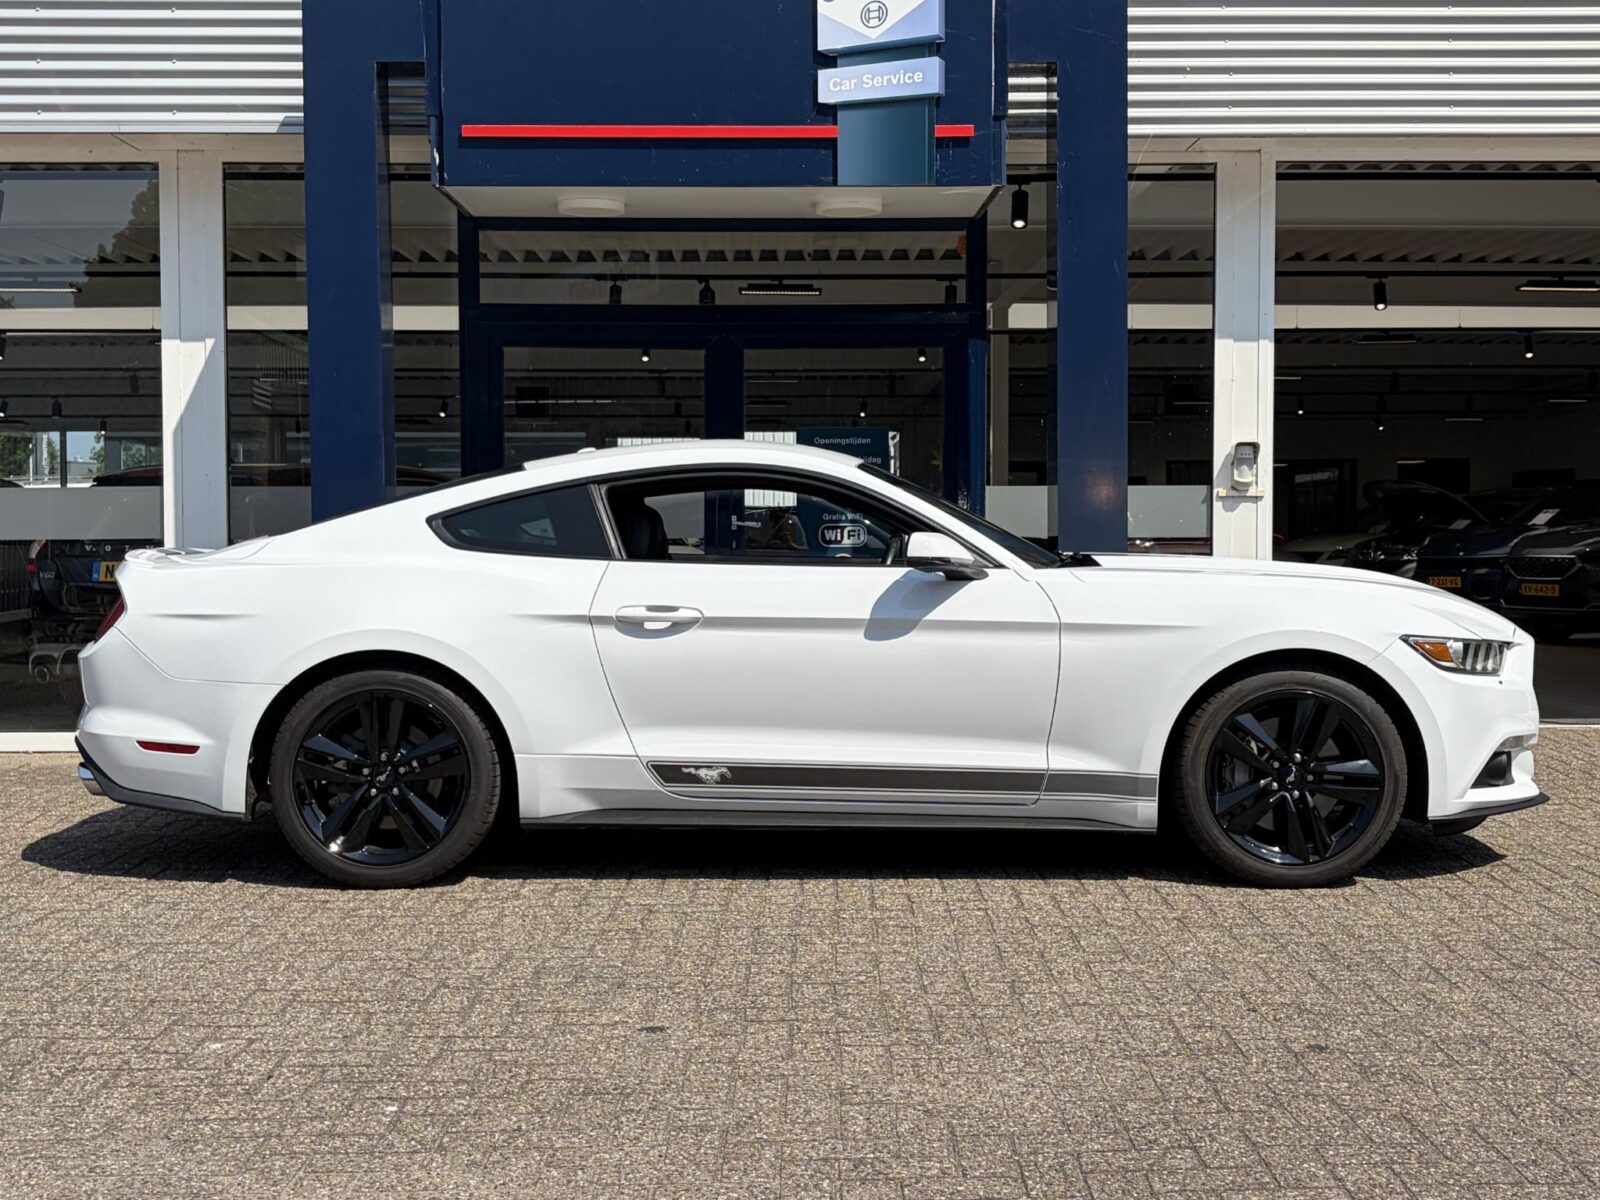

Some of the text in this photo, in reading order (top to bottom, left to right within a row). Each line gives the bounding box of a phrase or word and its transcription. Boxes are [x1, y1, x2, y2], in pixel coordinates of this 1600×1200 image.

[829, 70, 924, 91] Car Service
[814, 437, 872, 446] Openingstijden
[39, 571, 55, 579] V60
